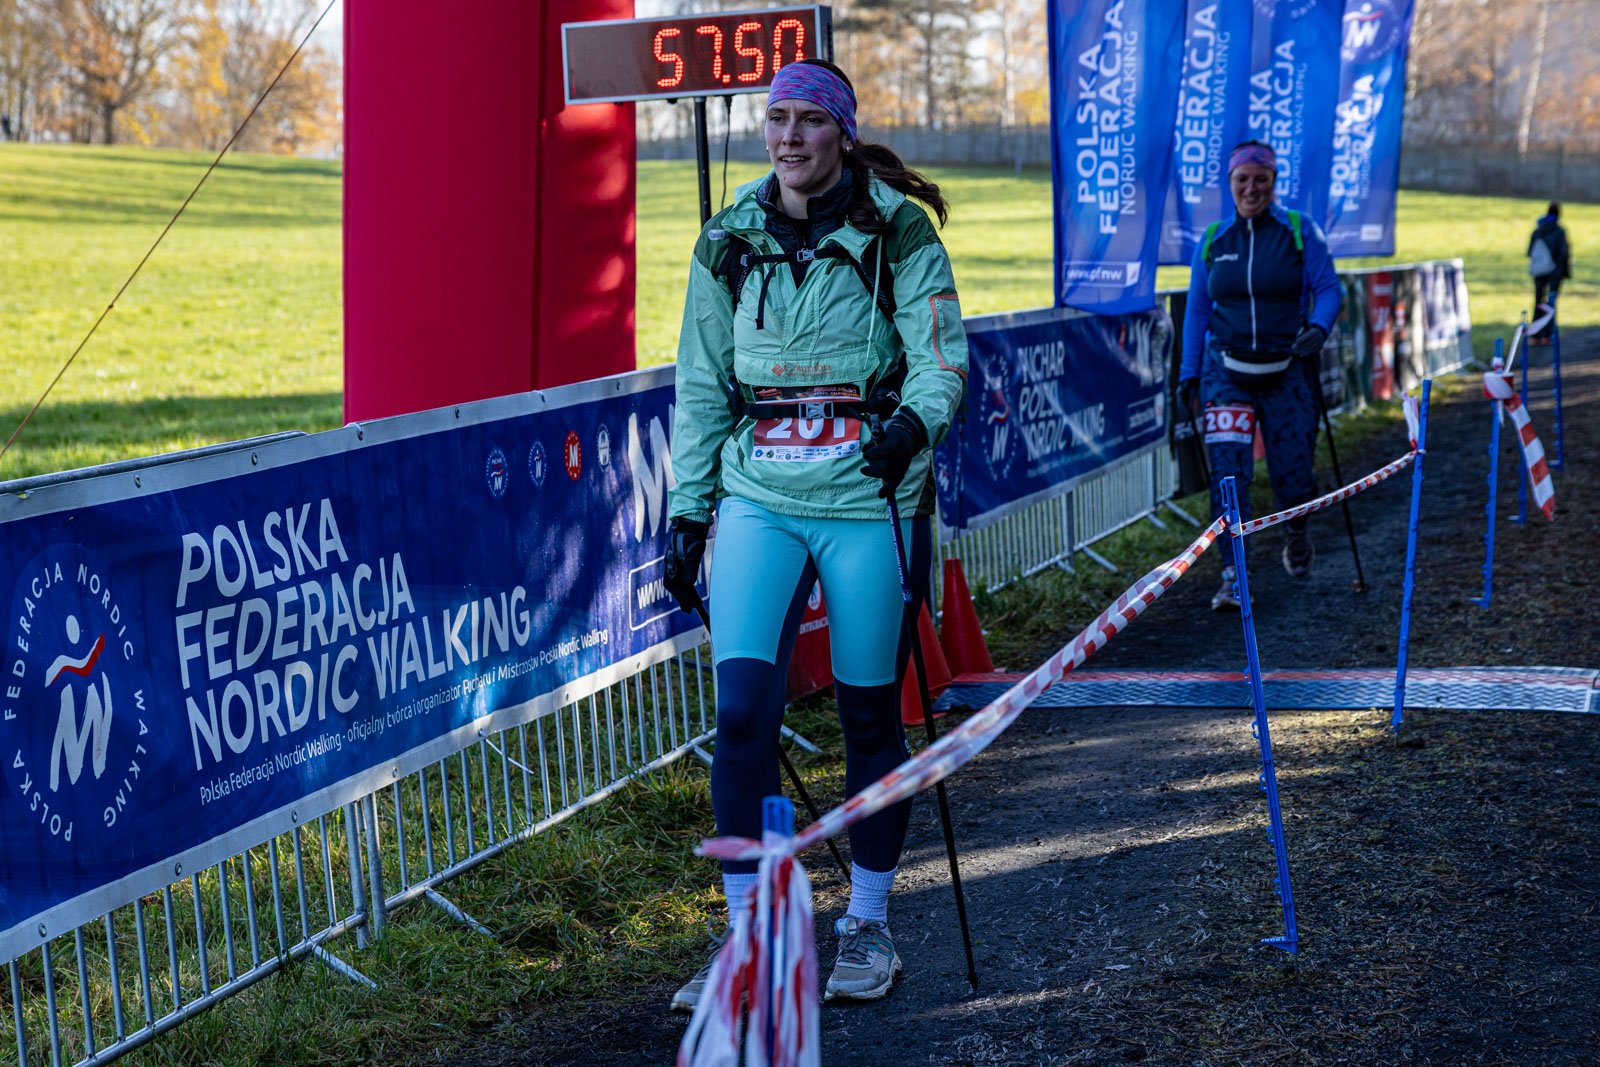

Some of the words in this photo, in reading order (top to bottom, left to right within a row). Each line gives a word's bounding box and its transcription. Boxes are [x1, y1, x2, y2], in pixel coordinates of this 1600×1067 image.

[1076, 43, 1101, 203] POLSKA
[1097, 0, 1124, 235] FEDERACJA
[1120, 29, 1138, 129] WALKING
[1181, 3, 1217, 203] FEDERACJA
[1212, 30, 1231, 115] WALKING
[1248, 69, 1273, 145] LSKA
[1120, 132, 1136, 215] NORDIC
[1205, 117, 1224, 188] NORDIC
[1329, 99, 1353, 198] POLSKA
[1205, 410, 1251, 432] 204
[176, 497, 349, 608] POLSKA
[5, 562, 64, 721] FEDERACJA
[77, 563, 134, 661] NORDIC
[175, 552, 416, 690] FEDERACJA
[185, 644, 360, 771] NORDIC
[367, 585, 531, 700] WALKING
[13, 749, 73, 842] POLSKA
[103, 689, 148, 828] WALKING
[200, 776, 231, 806] Polska
[230, 757, 275, 792] Federacja
[275, 744, 306, 773] Nordic
[306, 733, 342, 759] Walking
[347, 714, 386, 743] oficjalny
[416, 684, 462, 717] organizator
